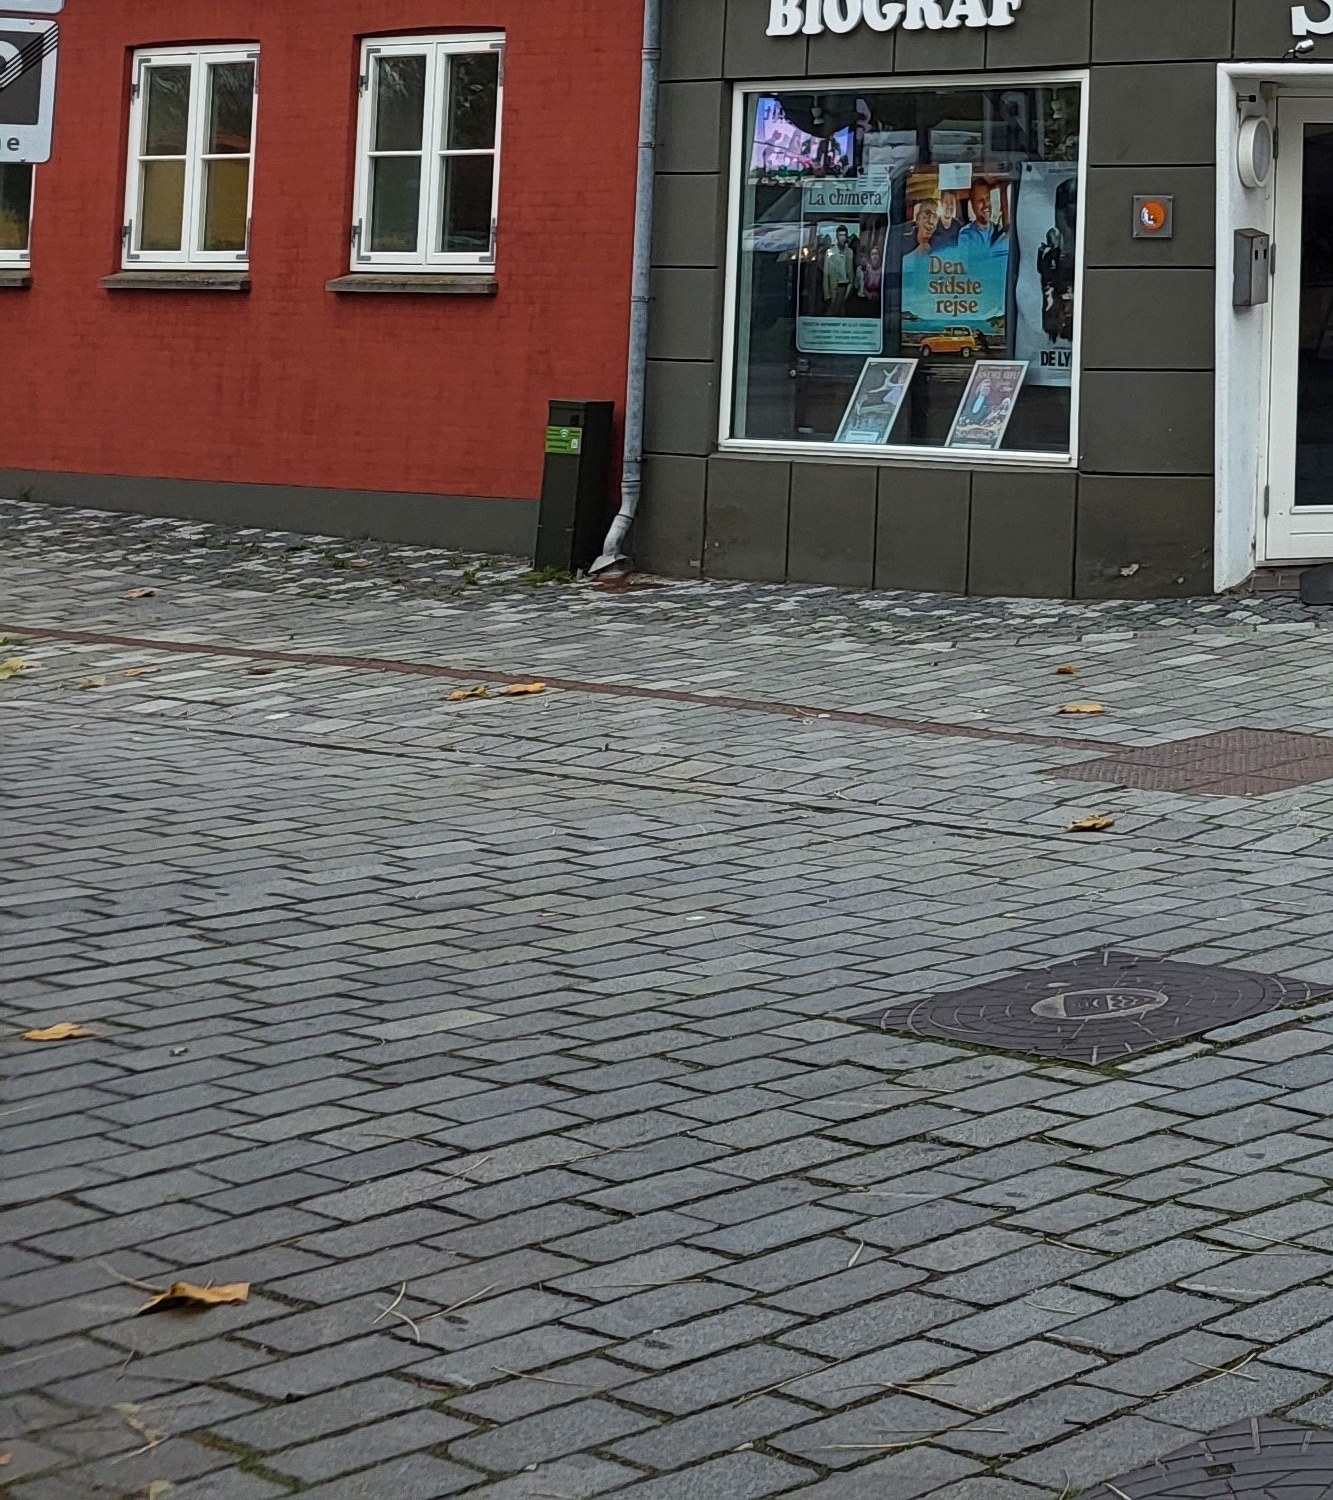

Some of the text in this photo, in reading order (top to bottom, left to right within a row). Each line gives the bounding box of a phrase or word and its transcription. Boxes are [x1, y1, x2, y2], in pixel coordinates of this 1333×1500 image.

[808, 188, 882, 206] La chimera
[928, 255, 964, 275] Den
[928, 276, 983, 295] sidste
[935, 295, 978, 317] rejse
[1040, 350, 1056, 367] DE
